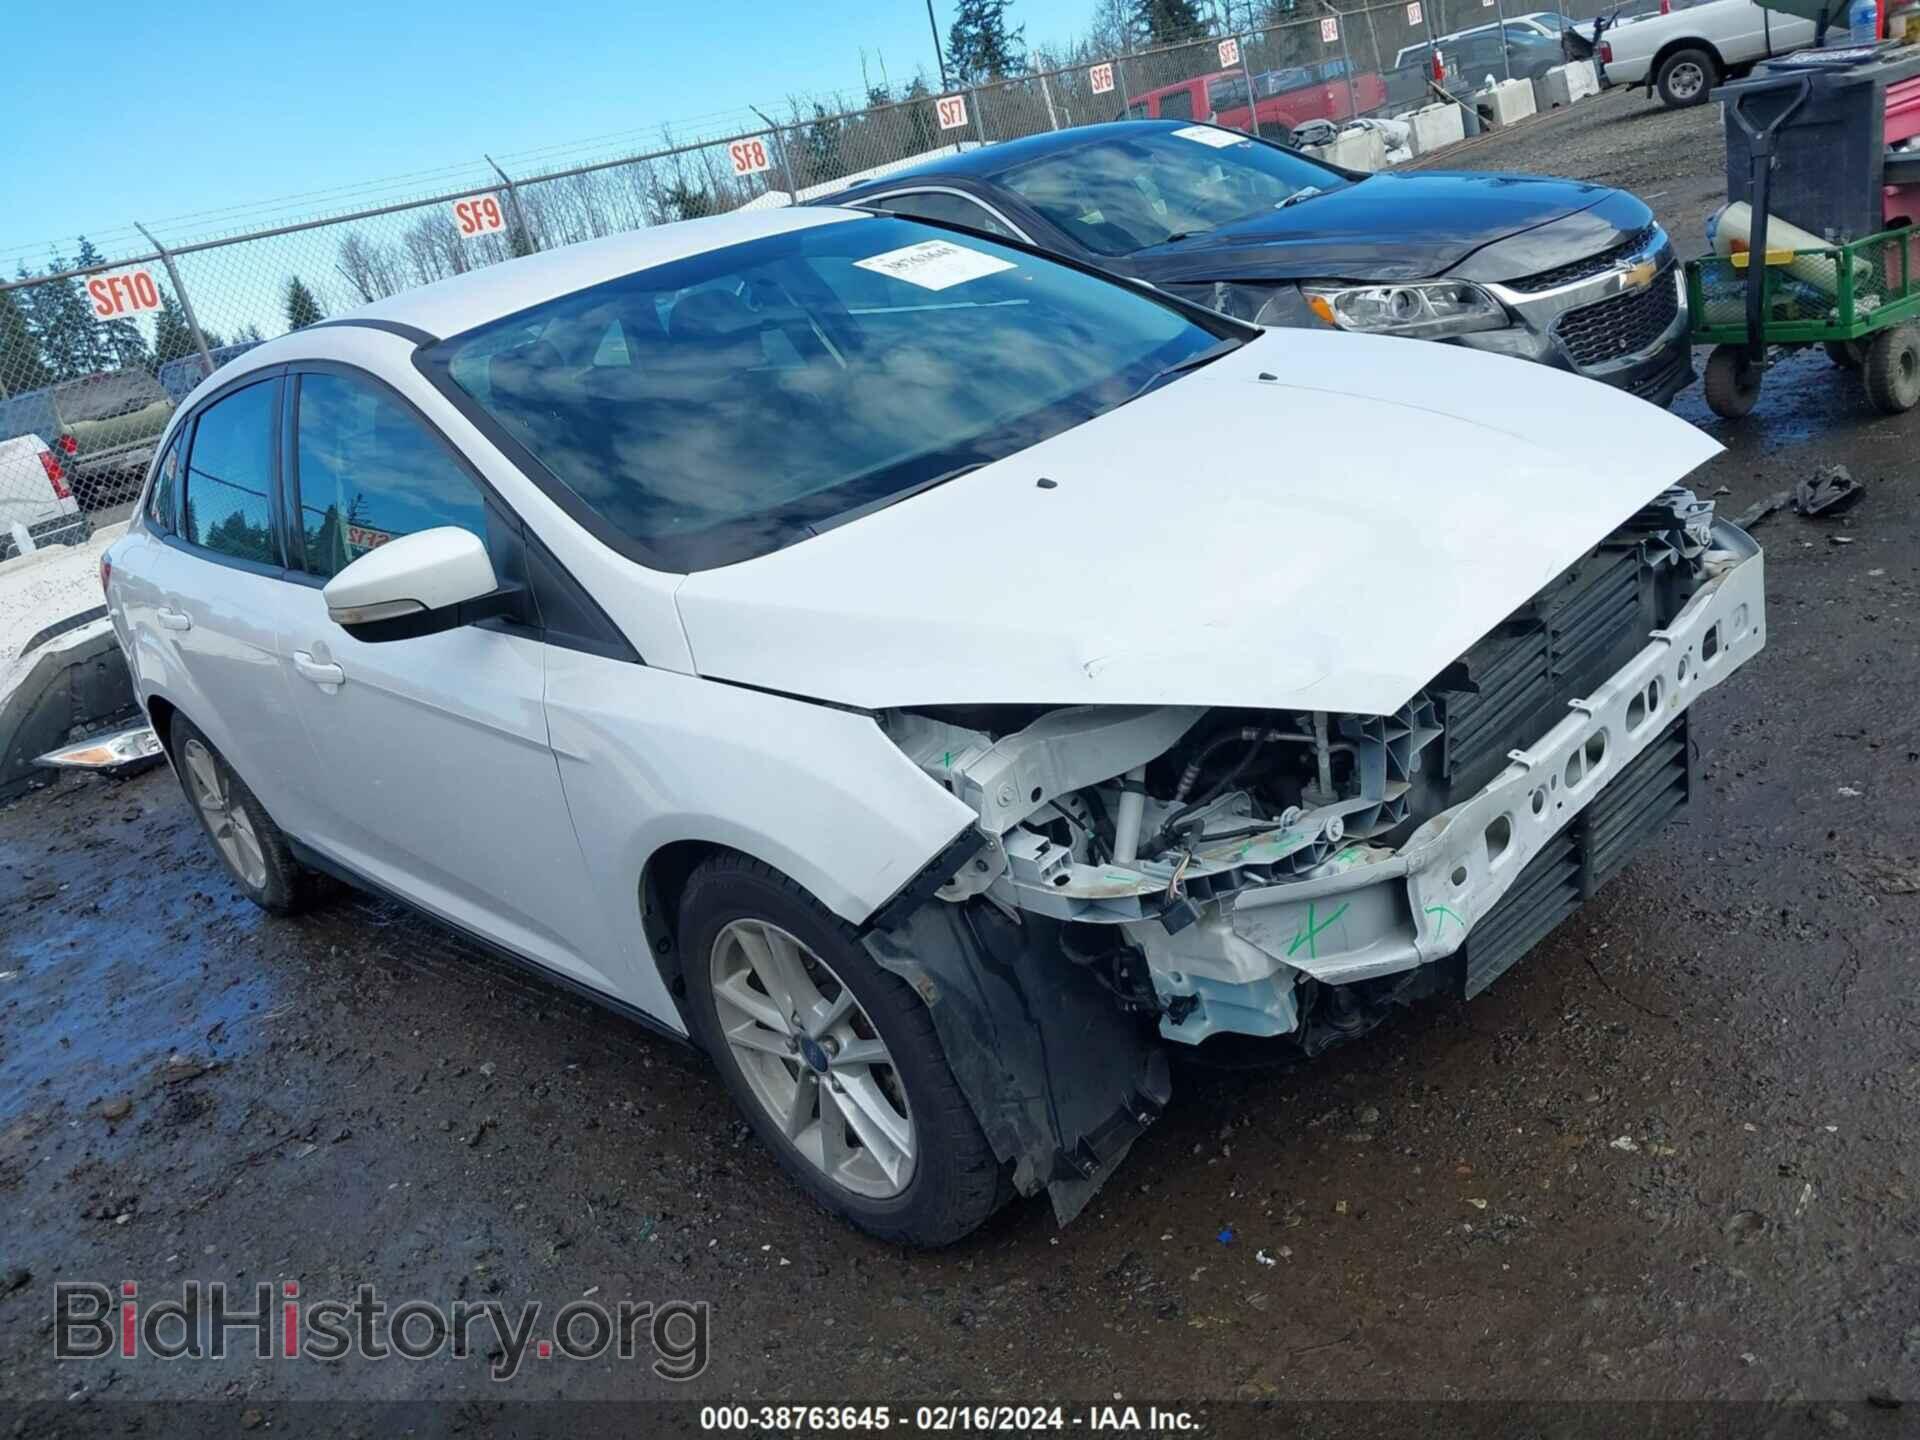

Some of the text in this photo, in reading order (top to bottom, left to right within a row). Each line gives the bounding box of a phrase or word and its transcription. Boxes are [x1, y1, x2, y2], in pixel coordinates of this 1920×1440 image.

[1092, 66, 1112, 90] SF6
[940, 100, 962, 125] SF7
[732, 141, 766, 171] SF8
[456, 198, 500, 233] SF9
[88, 271, 158, 315] SF10
